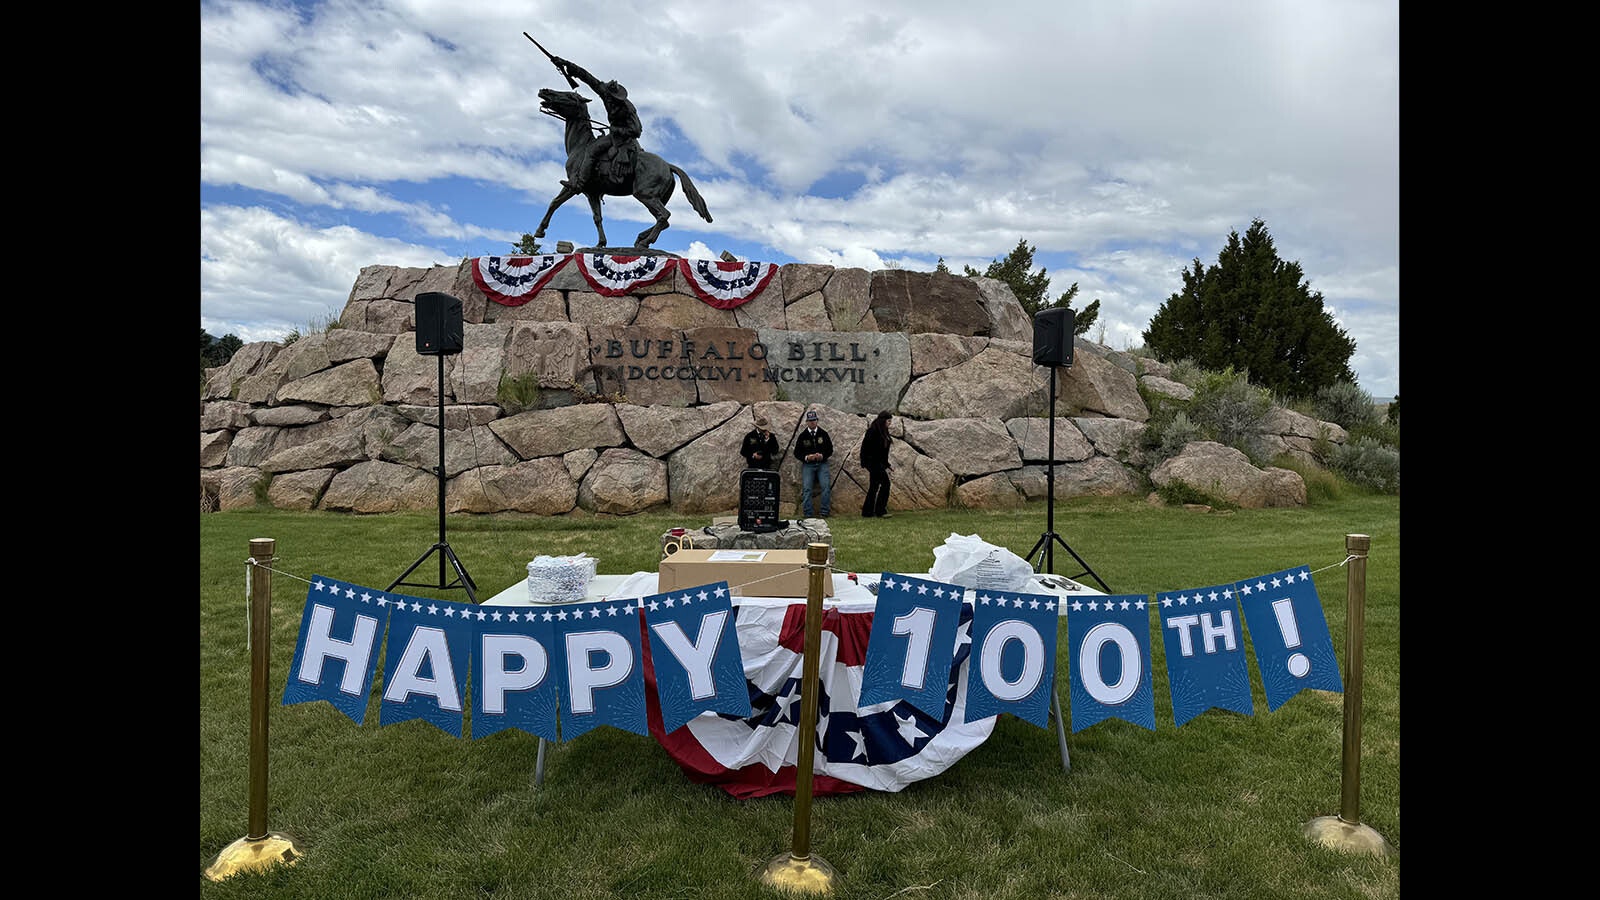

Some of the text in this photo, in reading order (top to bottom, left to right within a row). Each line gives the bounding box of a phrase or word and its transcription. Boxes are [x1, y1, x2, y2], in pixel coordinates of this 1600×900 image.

[605, 340, 866, 361] BUFFALO BILL
[297, 602, 730, 715] HAPPY
